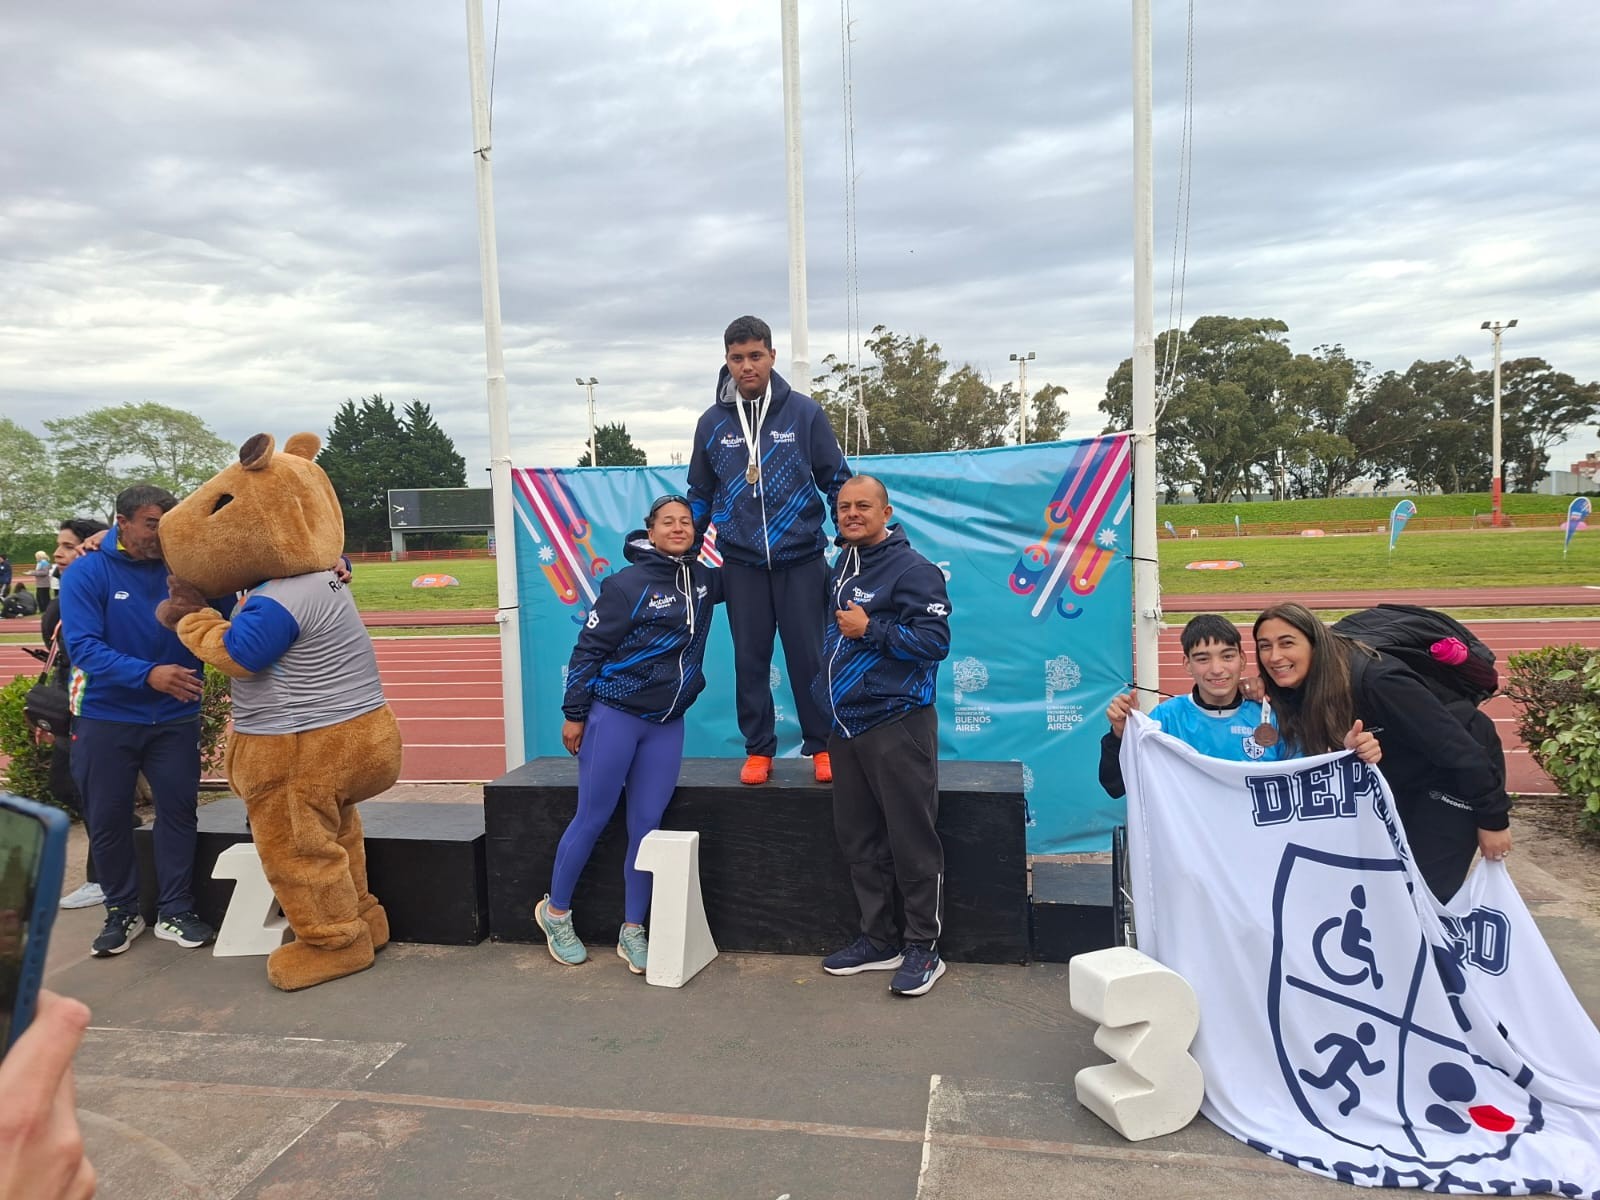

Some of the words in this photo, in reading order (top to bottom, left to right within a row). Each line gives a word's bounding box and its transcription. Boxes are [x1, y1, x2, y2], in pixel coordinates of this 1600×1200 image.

[955, 716, 991, 724] BUENOS
[634, 829, 719, 988] 1
[1069, 946, 1205, 1142] 3
